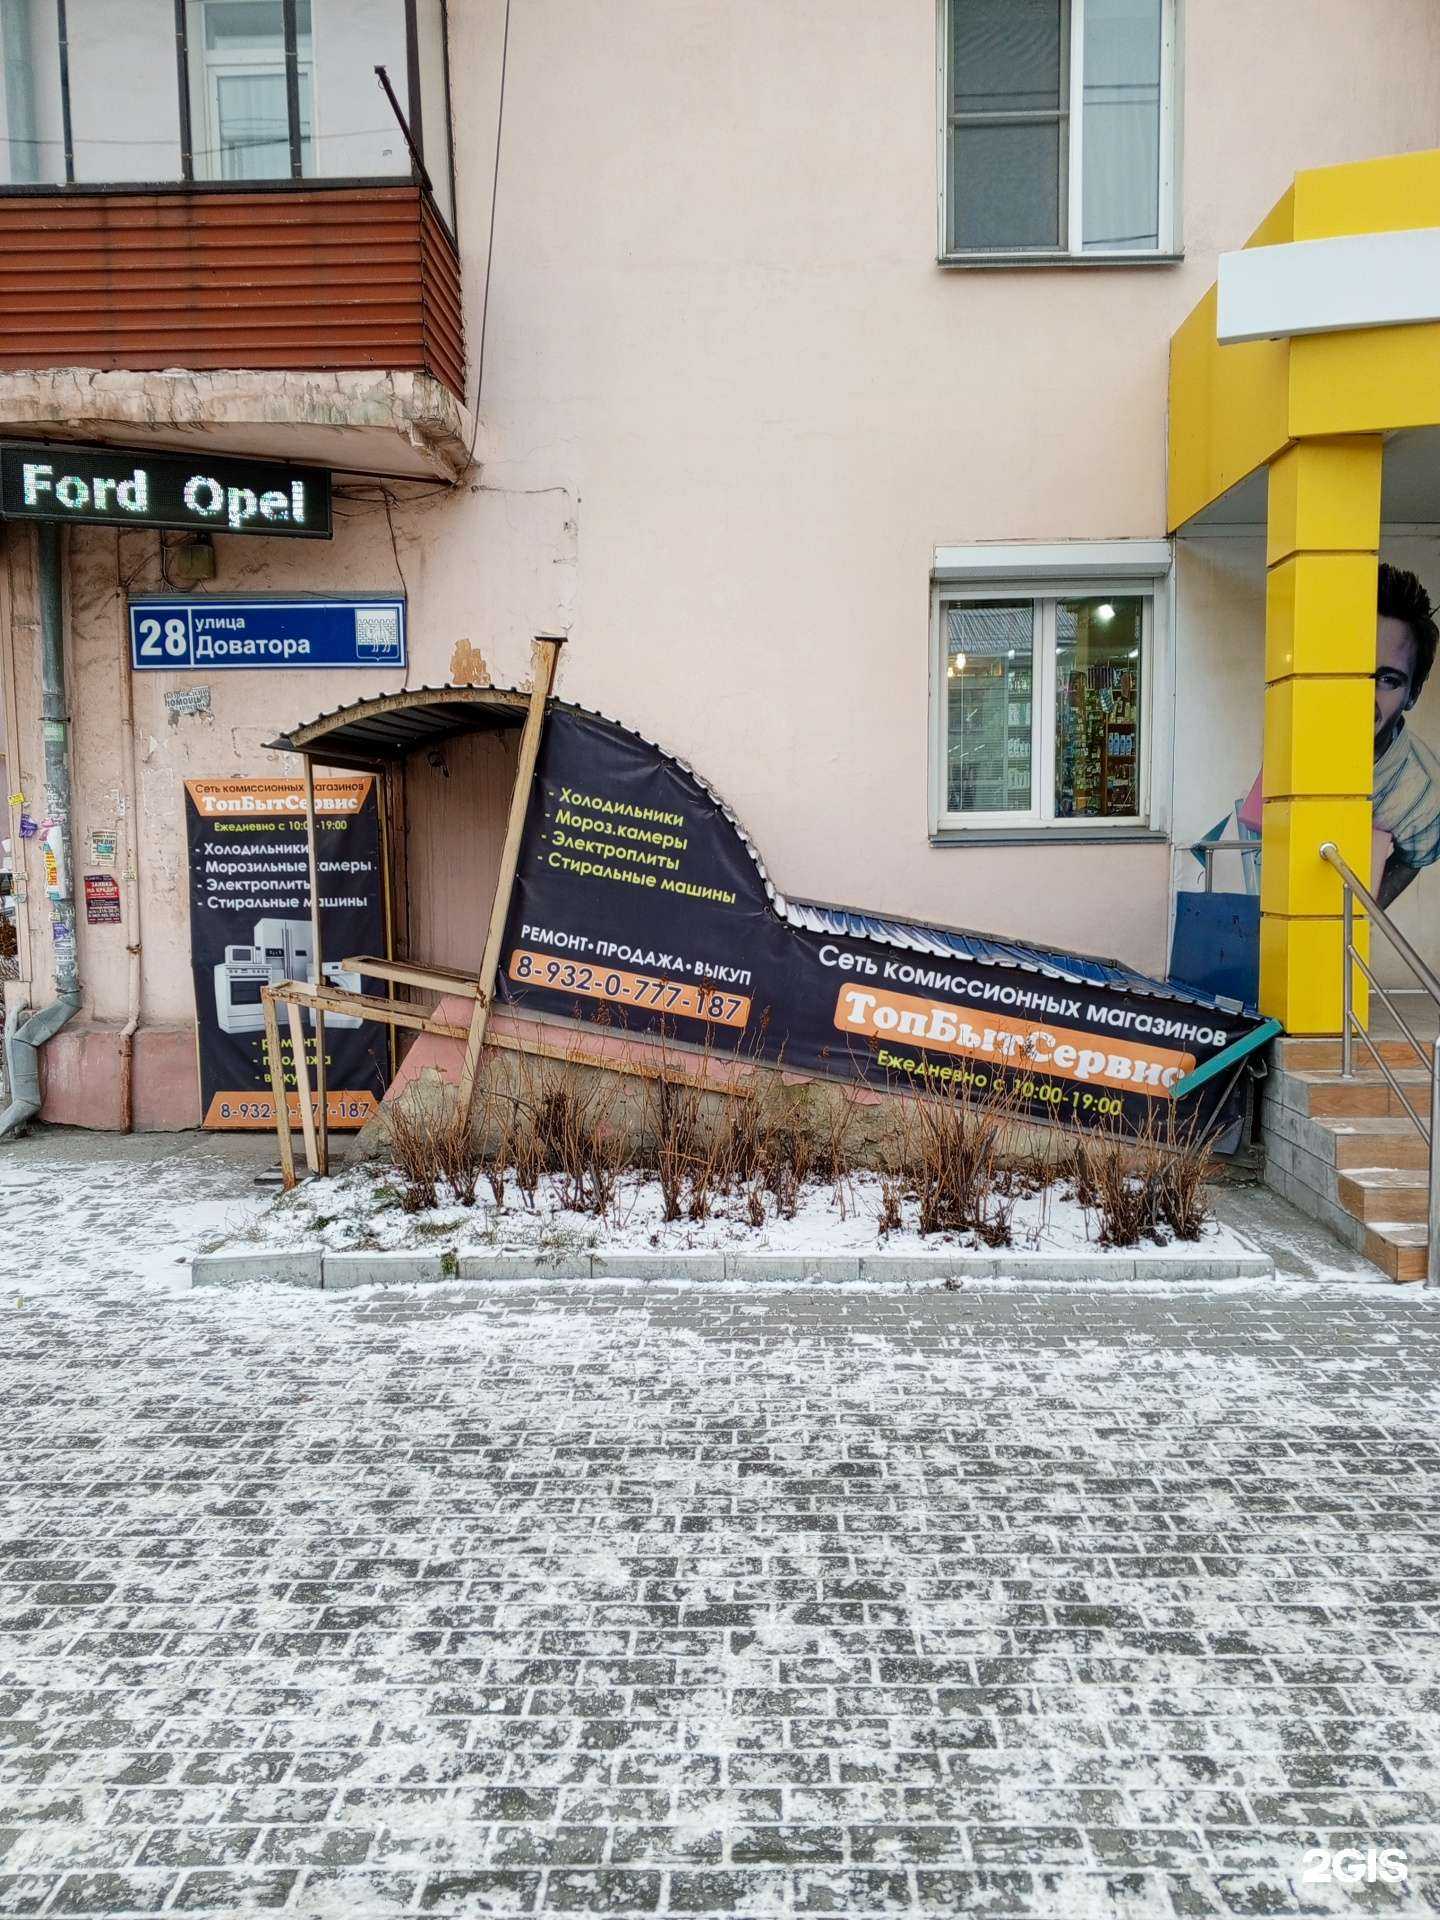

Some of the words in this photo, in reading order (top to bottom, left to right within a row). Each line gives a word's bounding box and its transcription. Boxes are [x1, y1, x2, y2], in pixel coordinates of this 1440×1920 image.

[22, 463, 149, 512] Ford
[183, 475, 304, 527] Opel
[139, 618, 187, 656] 28
[195, 617, 246, 633] улица
[195, 635, 311, 659] Доватора
[195, 783, 221, 794] Сеть
[222, 783, 305, 793] комиссионных
[312, 783, 365, 792] агазинов
[202, 795, 359, 814] ТопБытСервис
[560, 787, 684, 827] Холодильники
[213, 822, 276, 833] Ежедневно
[555, 809, 688, 850] Мороз.камеры
[204, 843, 309, 856] Холодильники
[205, 861, 307, 875] Морозильные
[316, 861, 372, 874] амеры
[552, 831, 680, 870] Электроплиты
[548, 852, 657, 887] Стиральные
[660, 878, 736, 904] машины
[207, 897, 299, 911] Стиральные
[515, 954, 744, 1020] 8-932-0-777-187
[818, 944, 878, 976] Сеть
[883, 963, 1081, 1019] комиссионных
[1086, 1005, 1228, 1047] магазинов
[845, 991, 1186, 1088] ТопБытСервис
[877, 1050, 987, 1088] Ежедневно
